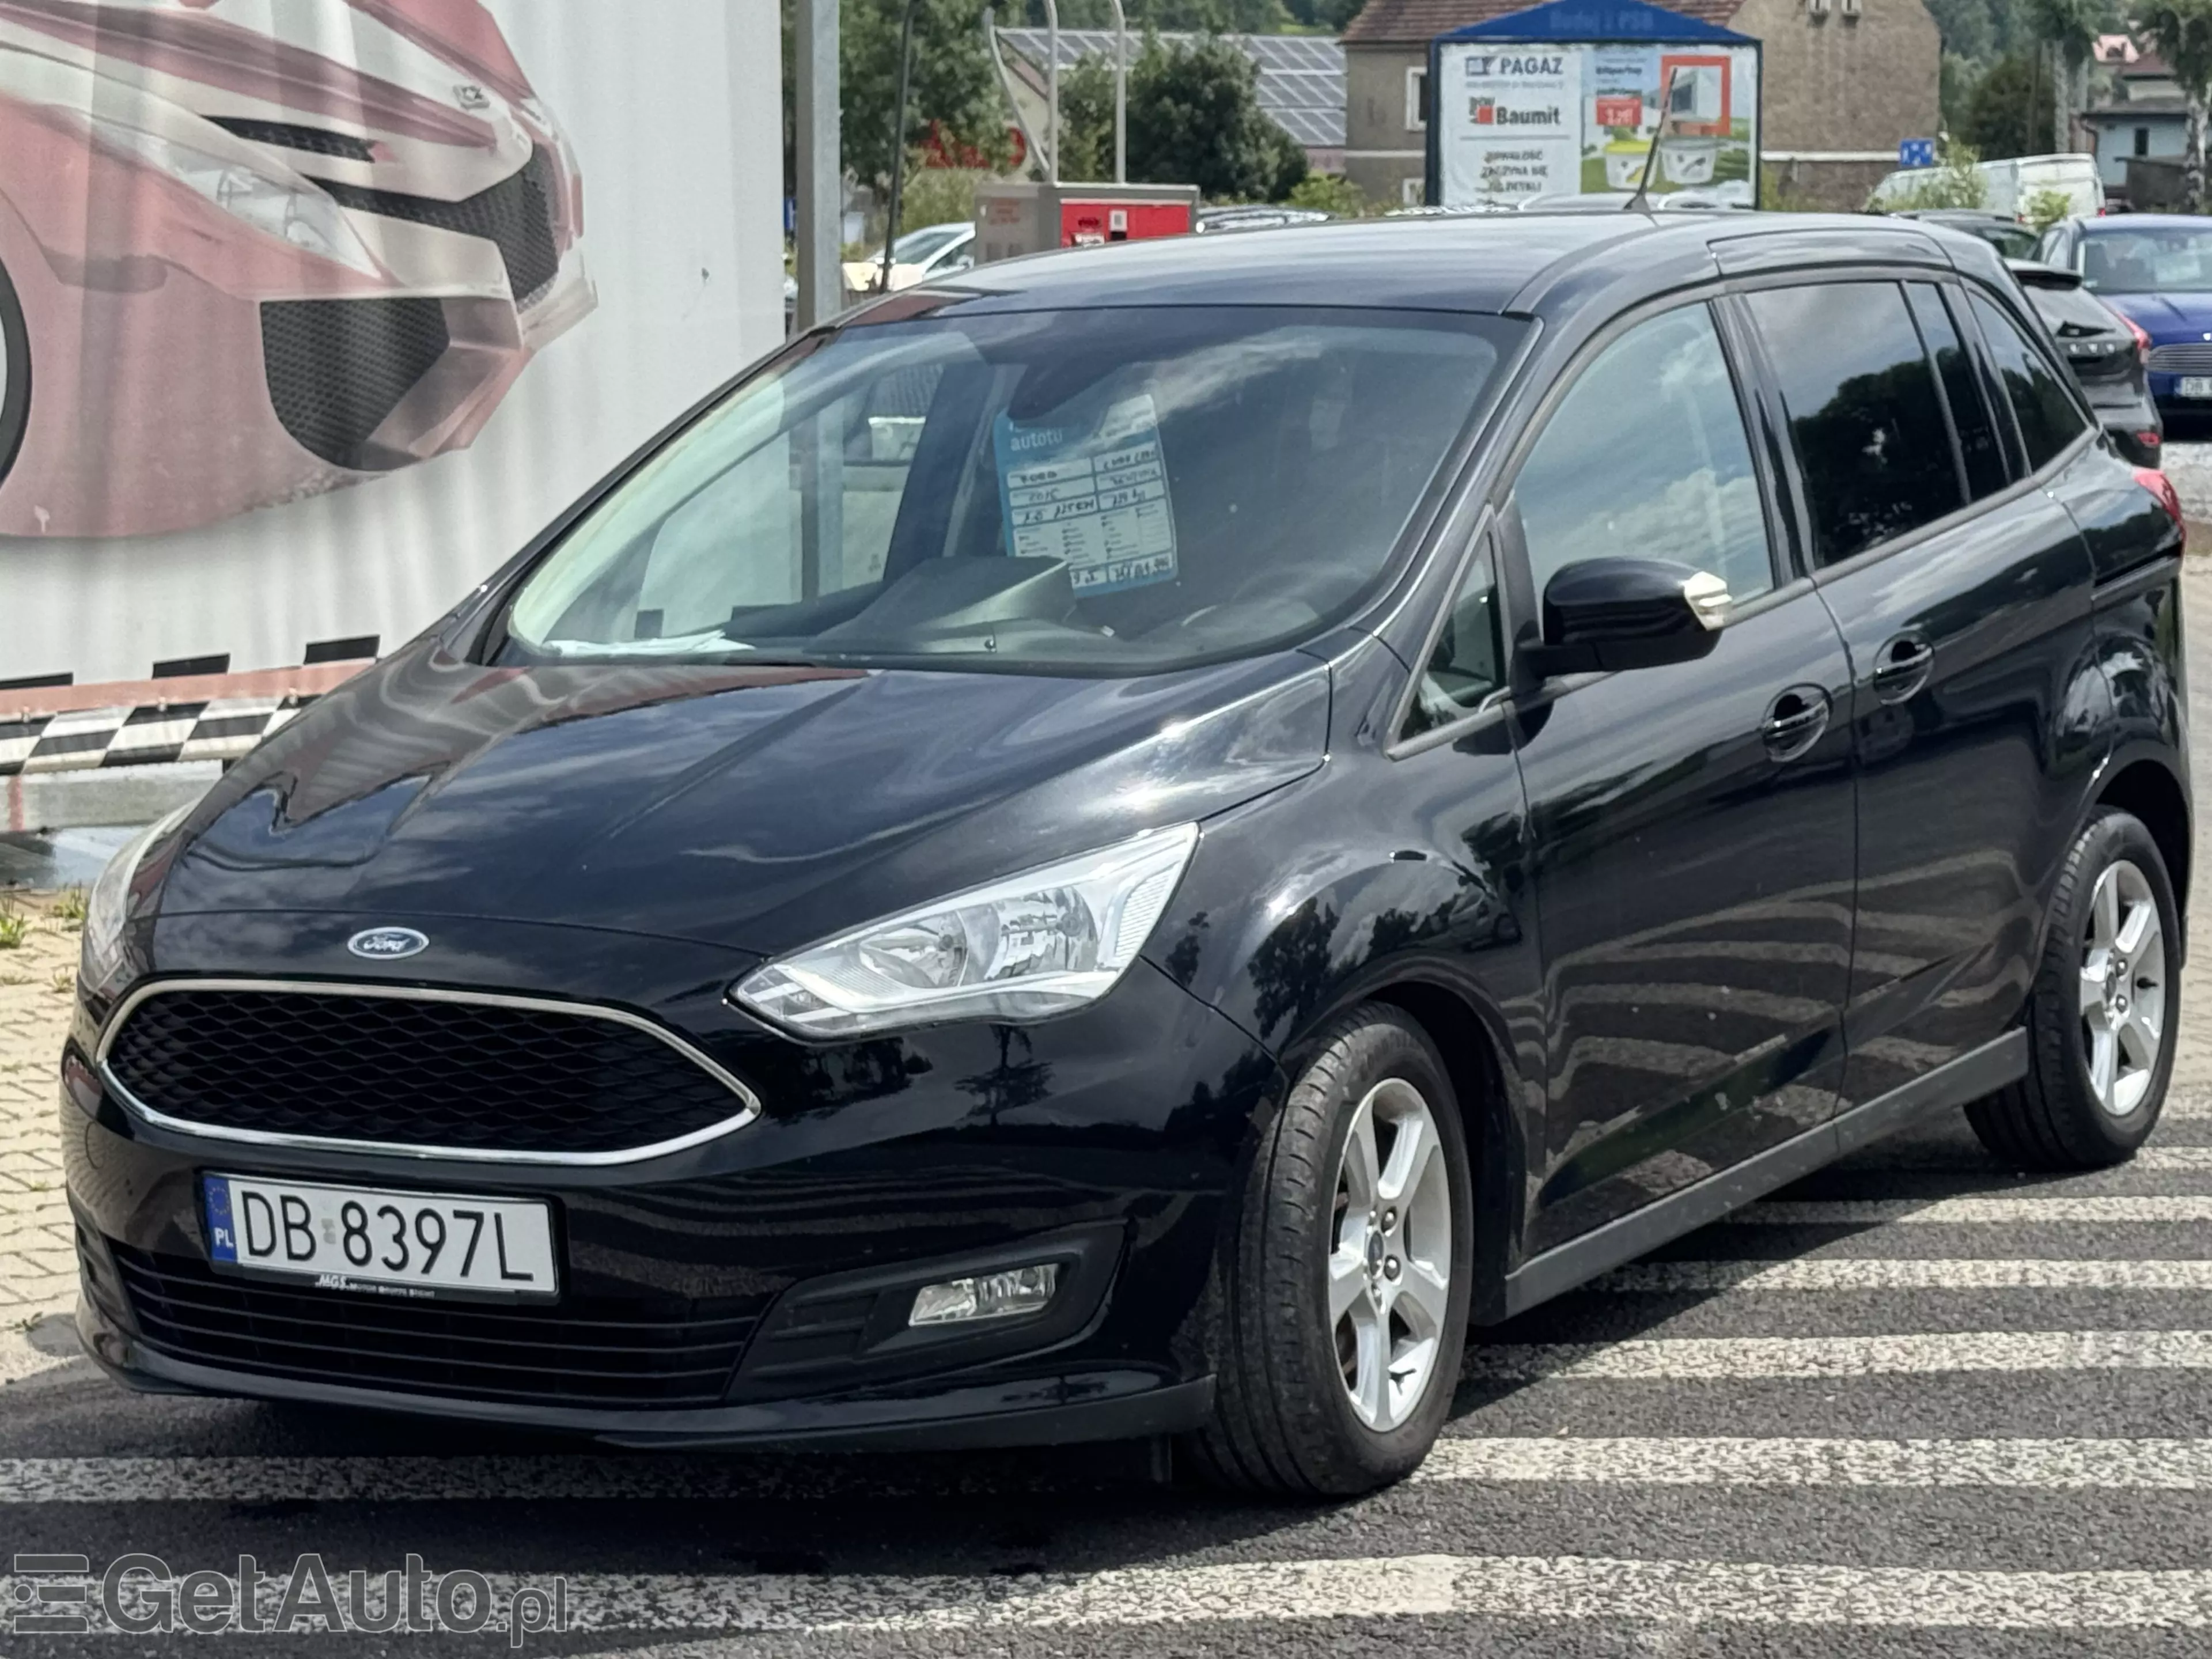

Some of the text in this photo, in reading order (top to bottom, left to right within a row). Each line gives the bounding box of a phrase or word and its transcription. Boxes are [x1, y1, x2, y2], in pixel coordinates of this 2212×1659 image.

[1500, 56, 1563, 75] PAGAZ
[1496, 105, 1561, 125] Baumit
[214, 1227, 234, 1248] PL
[241, 1190, 535, 1282] DB 8397L
